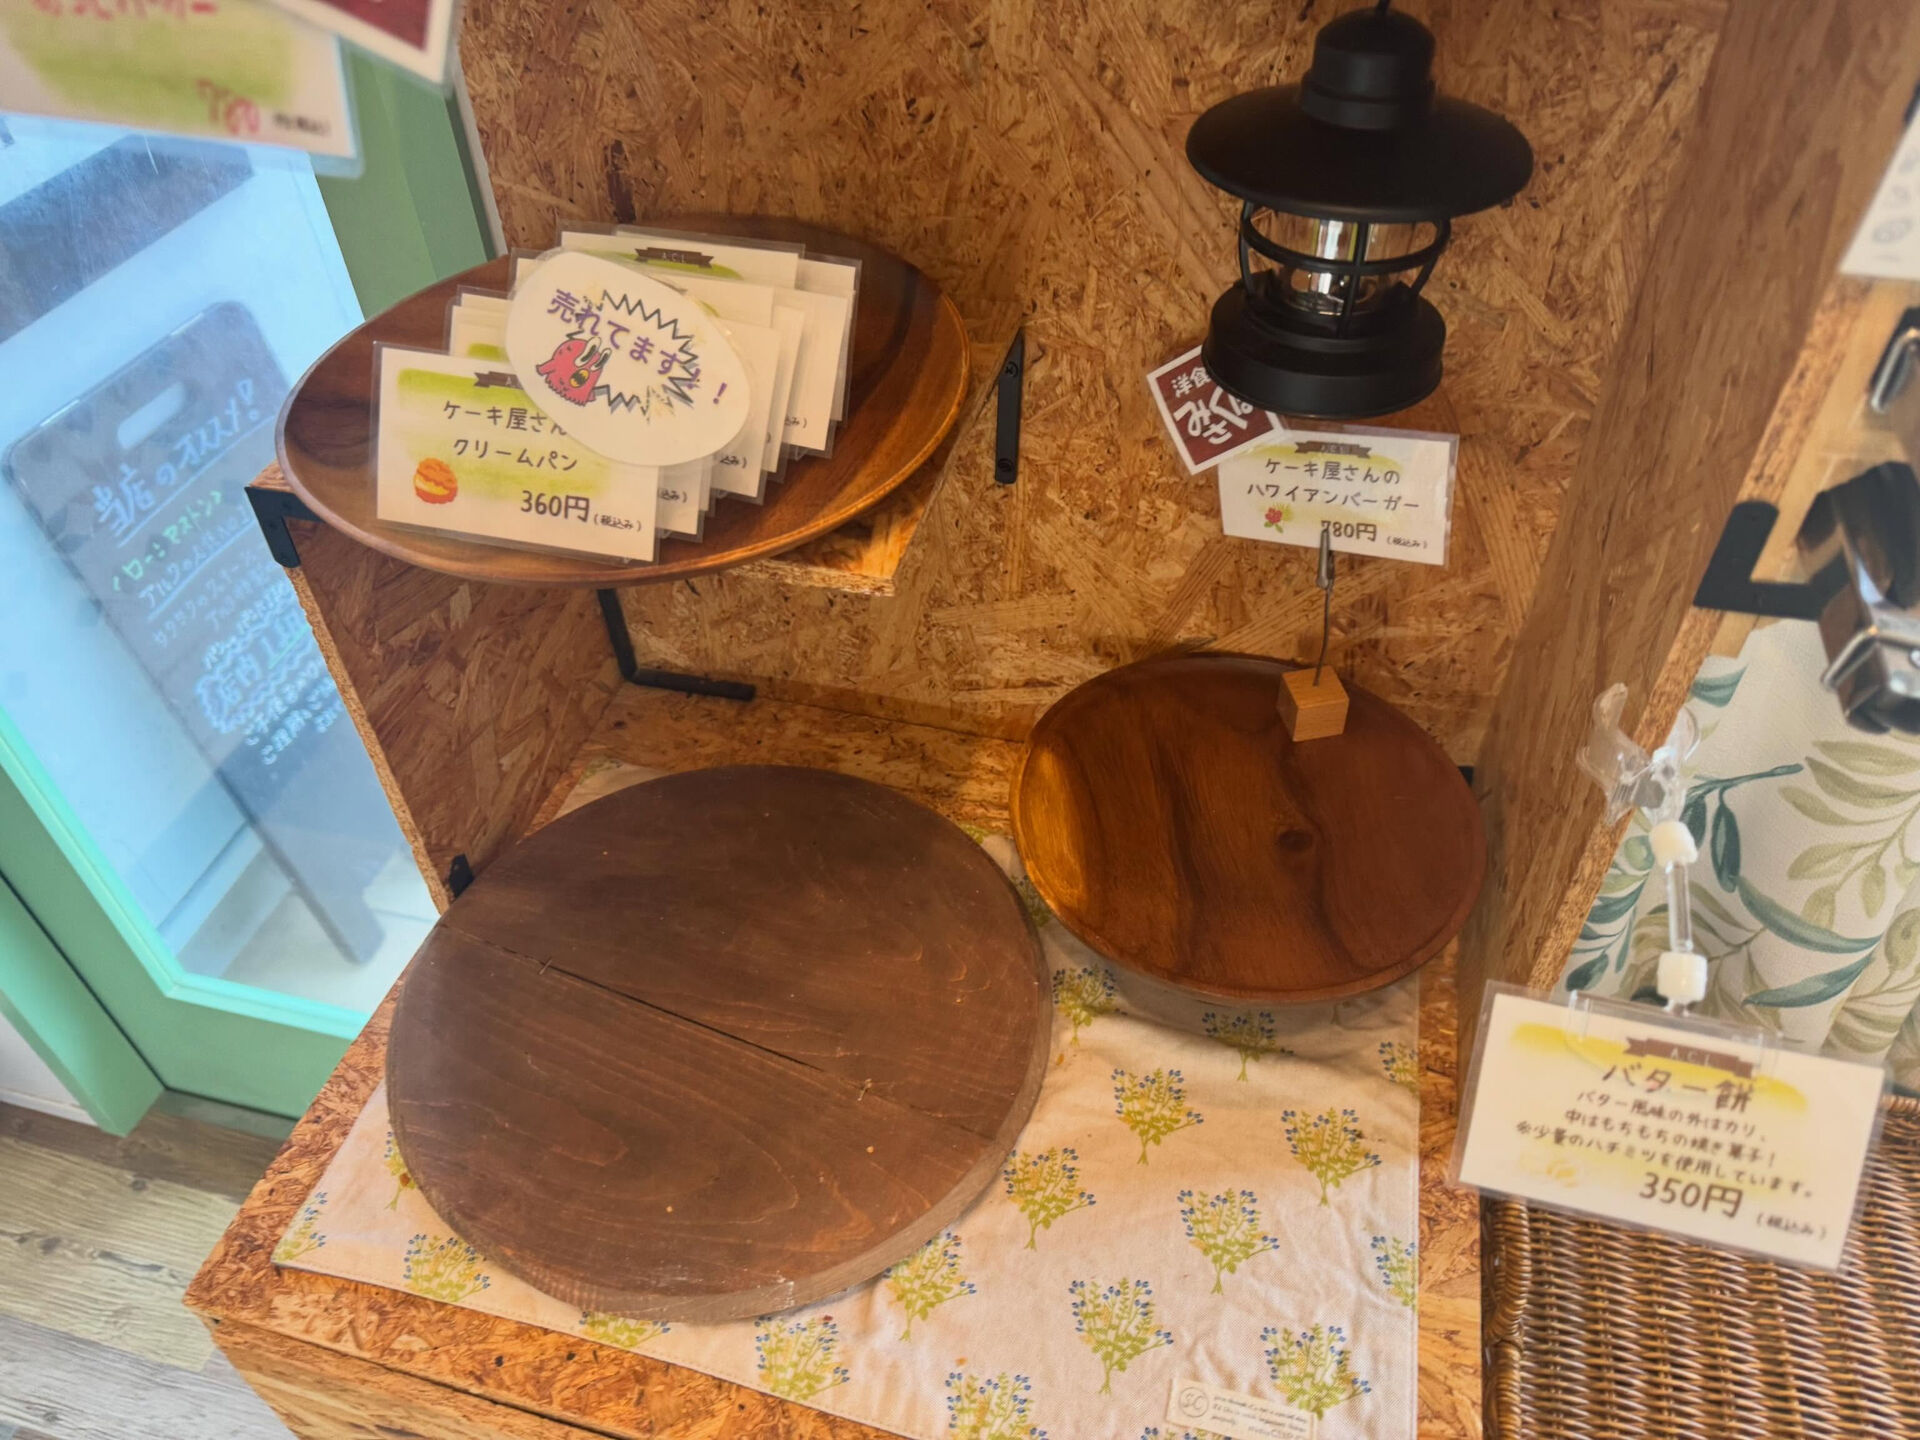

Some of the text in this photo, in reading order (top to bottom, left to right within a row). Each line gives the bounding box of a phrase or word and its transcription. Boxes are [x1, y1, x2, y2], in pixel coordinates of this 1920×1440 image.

[454, 439, 578, 471] クリームパン
[1265, 458, 1400, 485] ケーキ屋さんの
[520, 490, 590, 523] 360円
[1247, 484, 1420, 511] ハワイアンバーガー
[1602, 1062, 1754, 1113] バター餅
[1639, 1171, 1744, 1219] 350円
